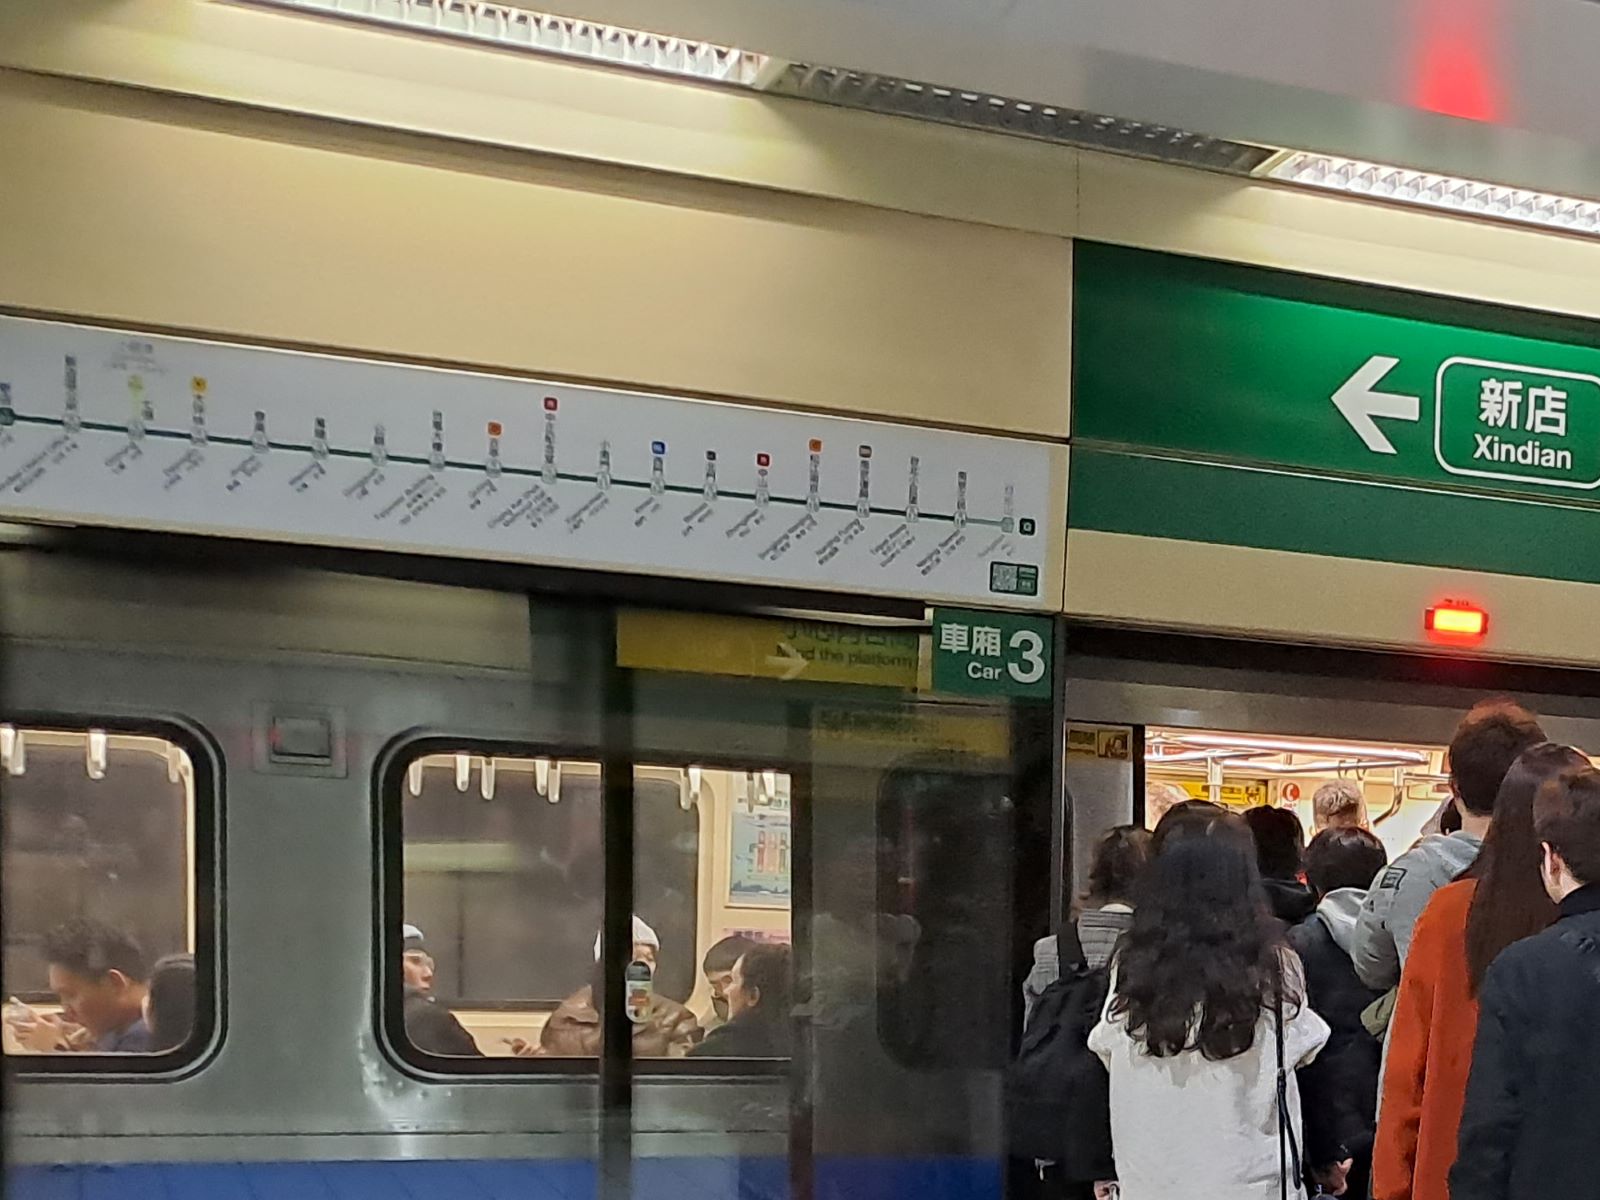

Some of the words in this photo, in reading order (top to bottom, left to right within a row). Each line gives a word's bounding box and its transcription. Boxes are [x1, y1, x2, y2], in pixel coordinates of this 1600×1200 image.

[1478, 377, 1568, 437] 新店
[1472, 433, 1572, 470] Xindian
[939, 623, 1001, 657] 車廂
[1007, 629, 1045, 684] 3
[967, 661, 1002, 681] Car
